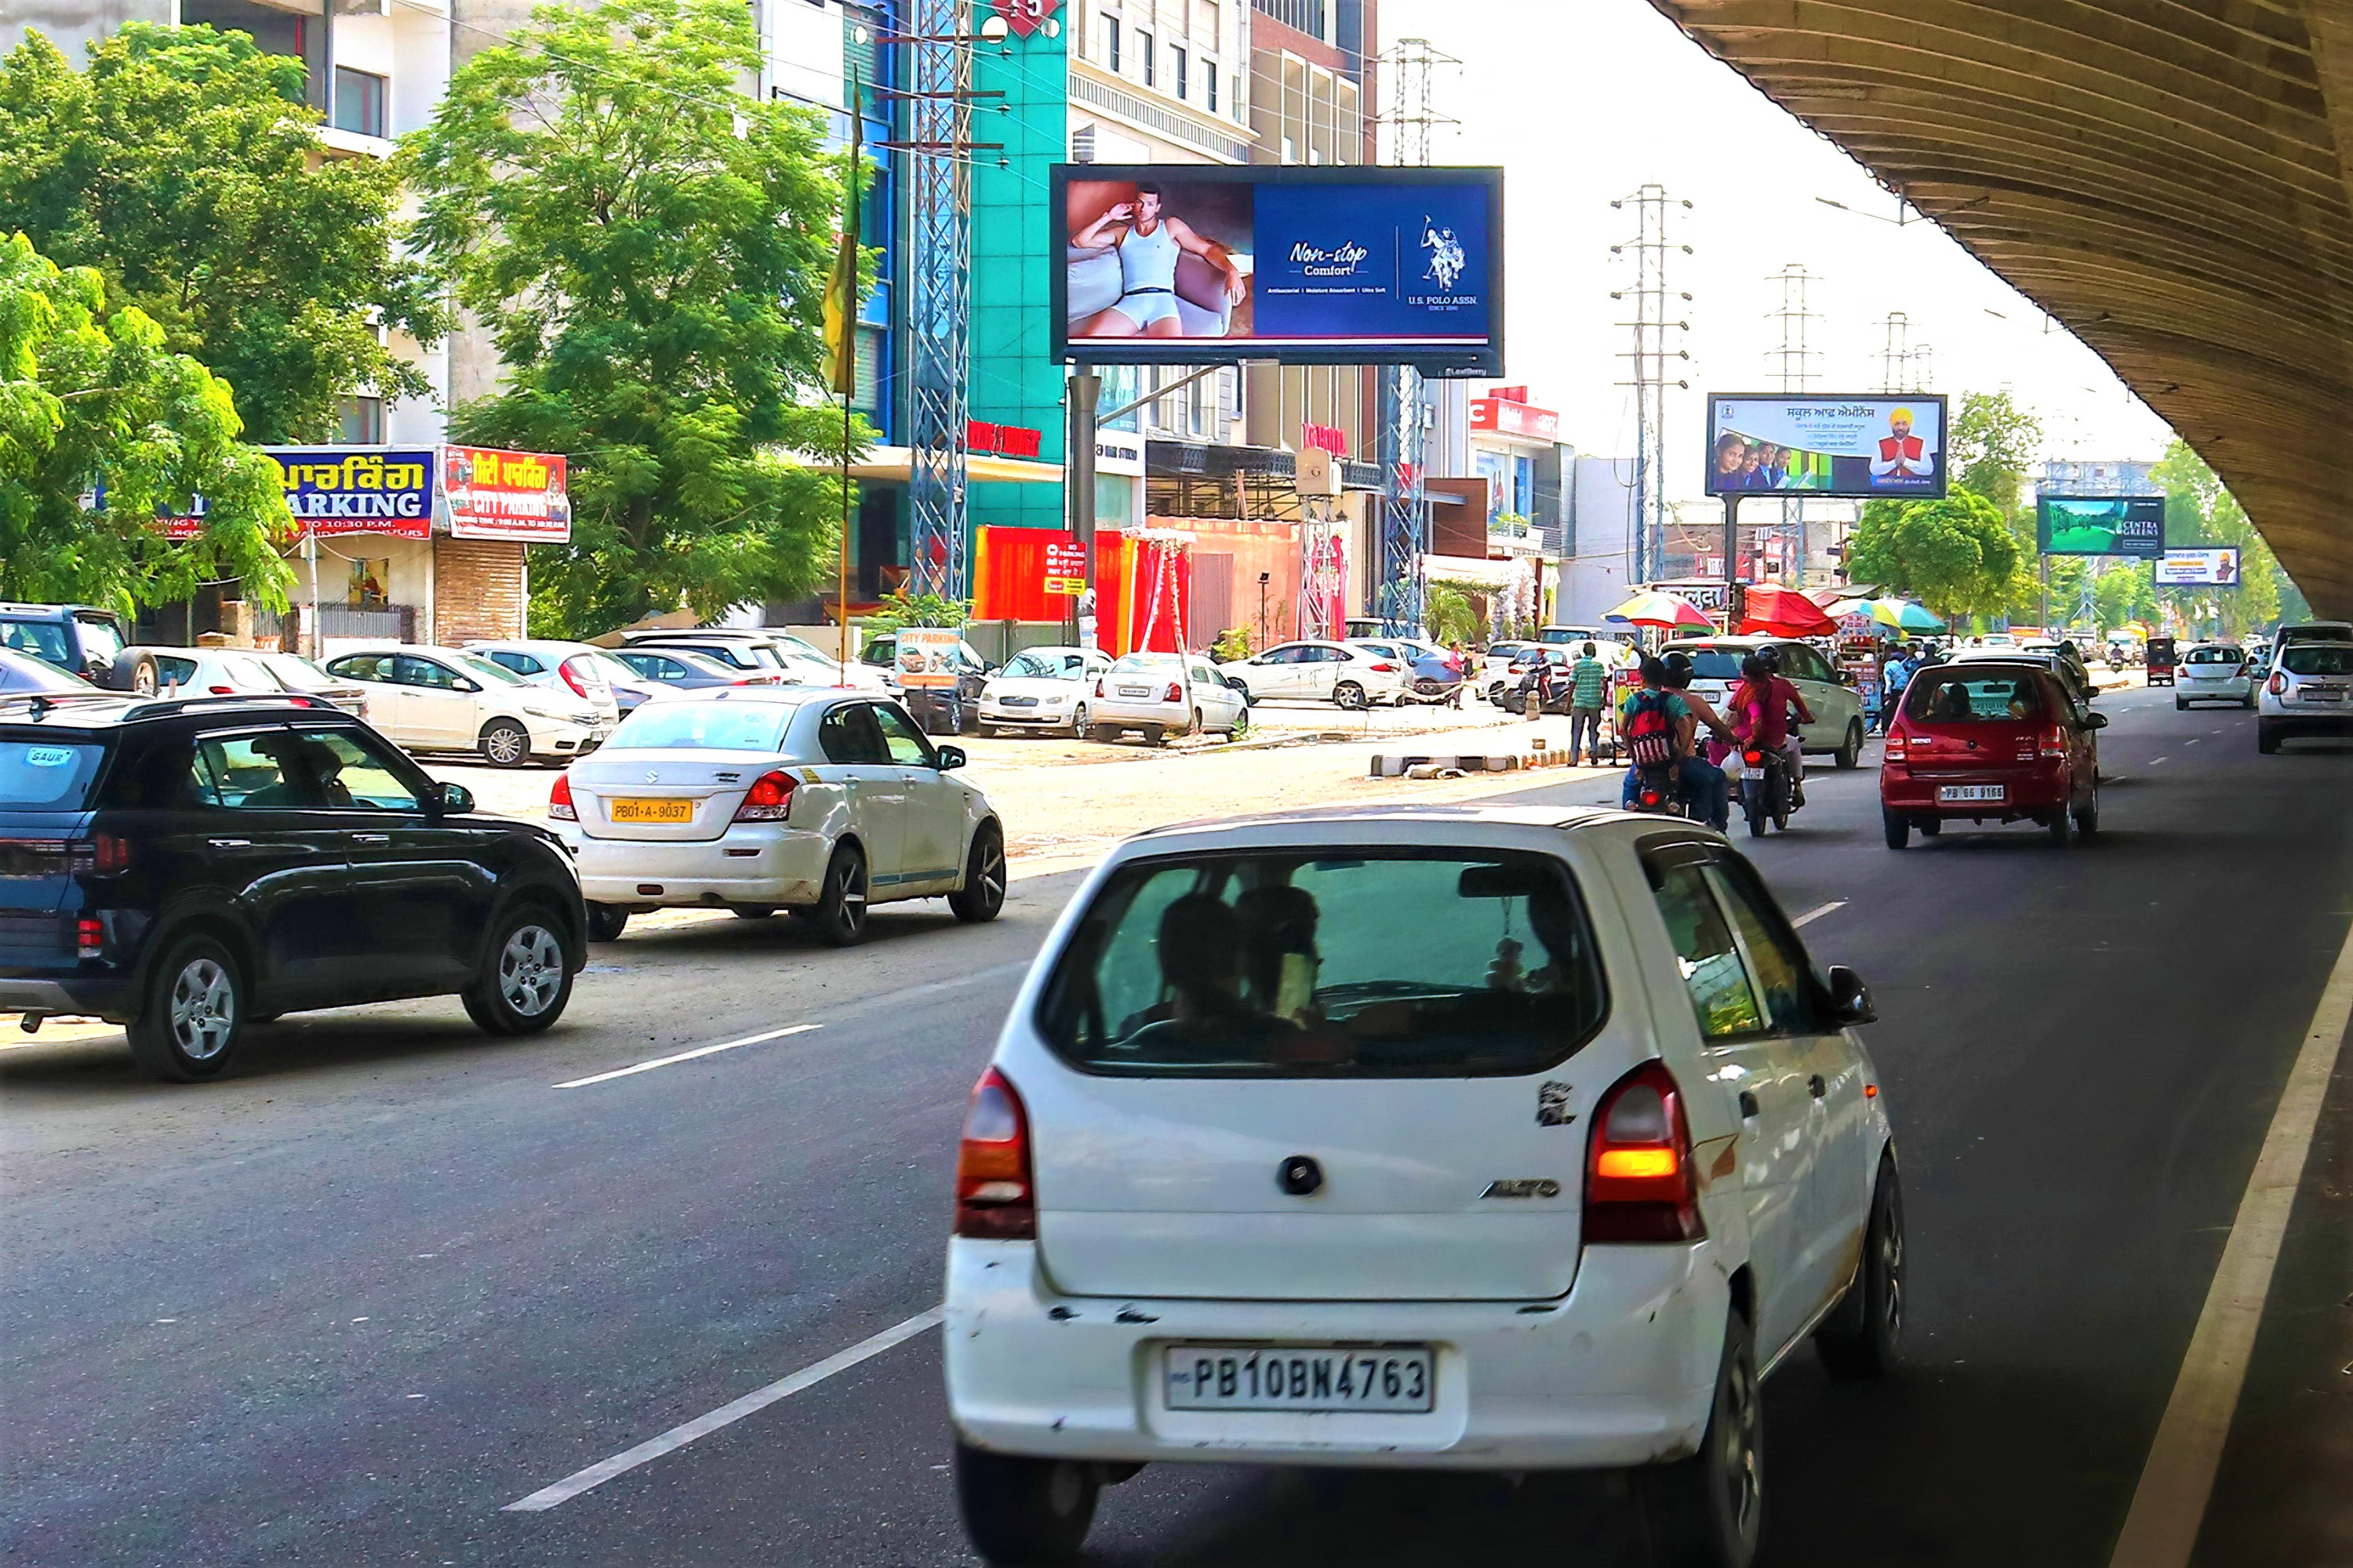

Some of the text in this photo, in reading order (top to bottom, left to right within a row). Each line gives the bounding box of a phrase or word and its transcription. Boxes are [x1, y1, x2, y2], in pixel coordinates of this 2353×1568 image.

[1289, 241, 1368, 273] Non-stop
[1304, 265, 1351, 276] Comfort
[285, 493, 422, 518] ARKING
[471, 490, 547, 518] CITY PARKING
[900, 632, 918, 643] CITY
[31, 752, 63, 762] GAUR
[1194, 1355, 1426, 1399] PB10BN4763
